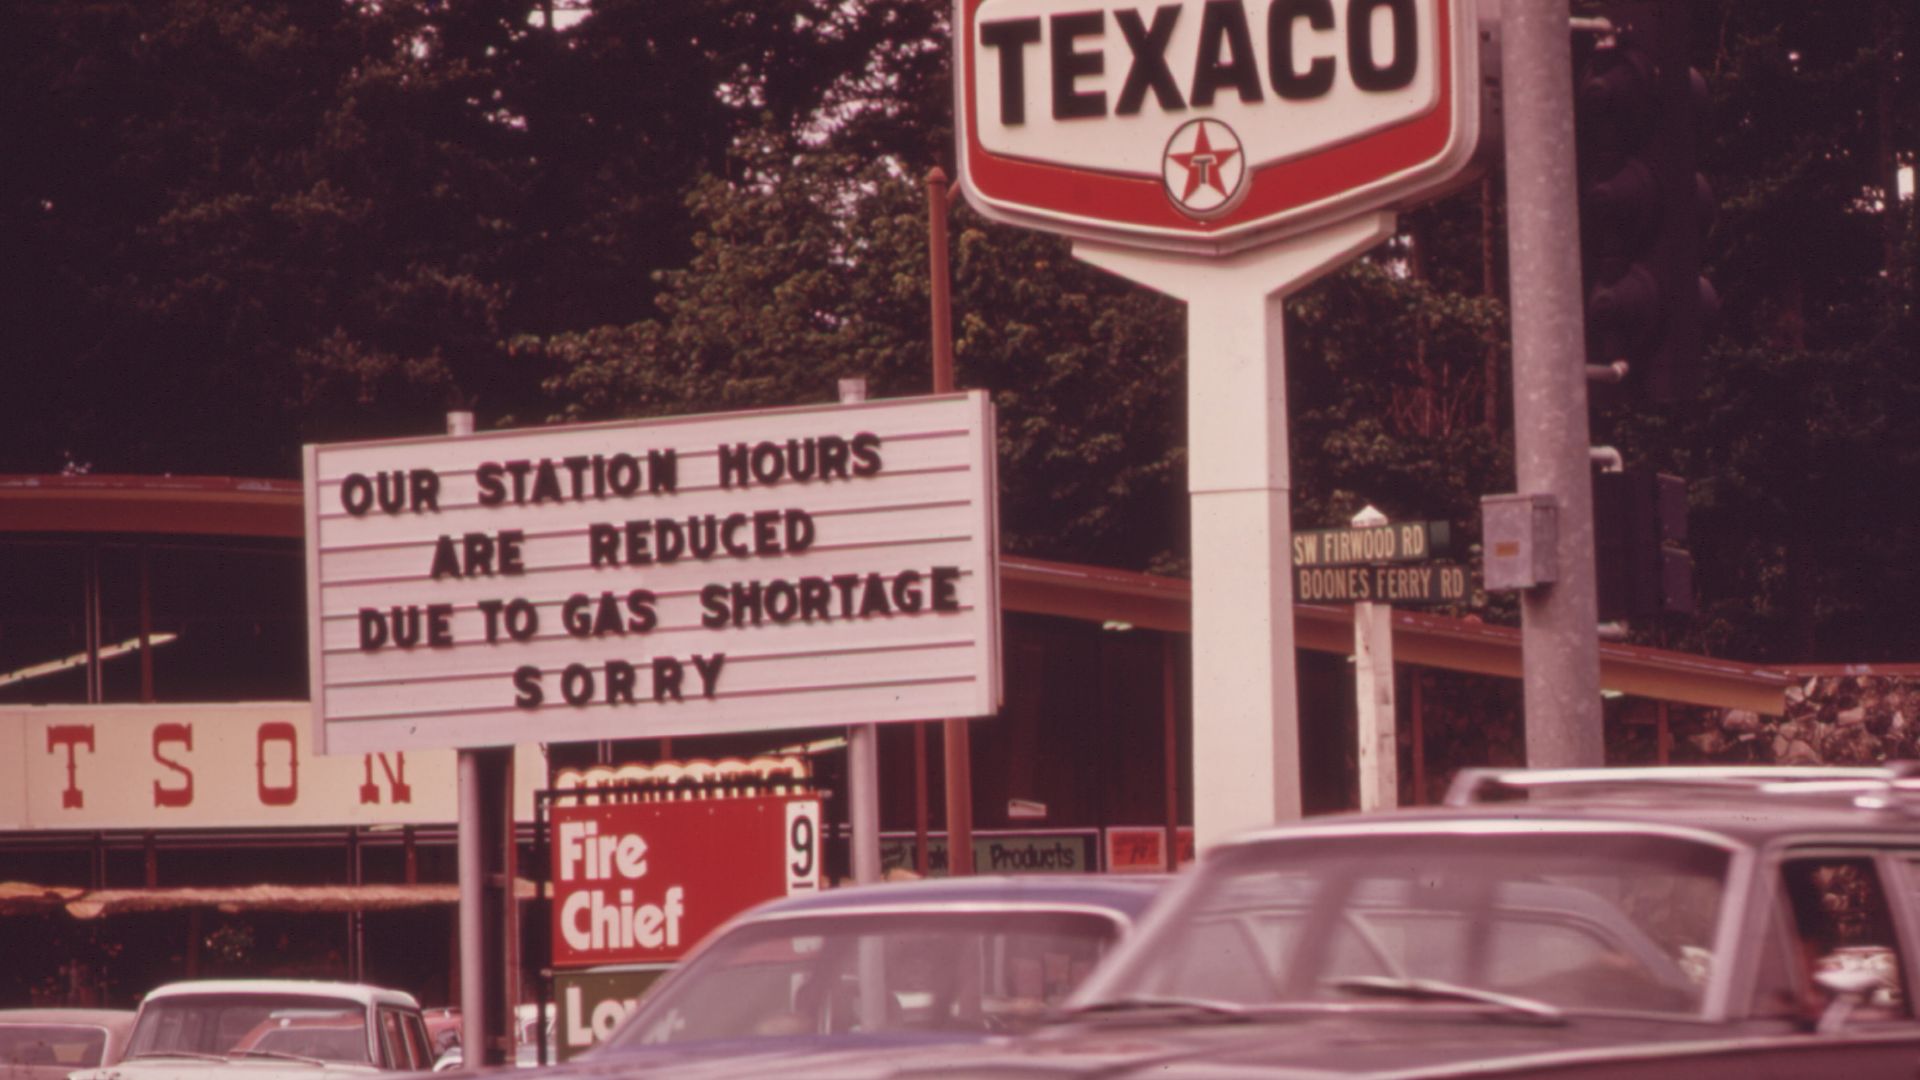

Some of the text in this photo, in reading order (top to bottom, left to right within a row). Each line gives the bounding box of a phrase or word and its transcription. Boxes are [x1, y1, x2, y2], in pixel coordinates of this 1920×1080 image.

[980, 0, 1418, 126] TEXACO
[341, 432, 882, 515] OUR STATION HOURS
[430, 508, 815, 578] ARE REDUCED
[1294, 524, 1425, 566] SW FIRWOOD RD
[359, 566, 959, 651] DUE TO GAS SHORTAGE
[1300, 567, 1464, 600] BOONES FERRY RD
[513, 653, 725, 710] SORRY
[560, 821, 648, 881] Fire
[790, 814, 815, 878] 9
[990, 843, 1075, 870] Products
[560, 886, 684, 952] Chief
